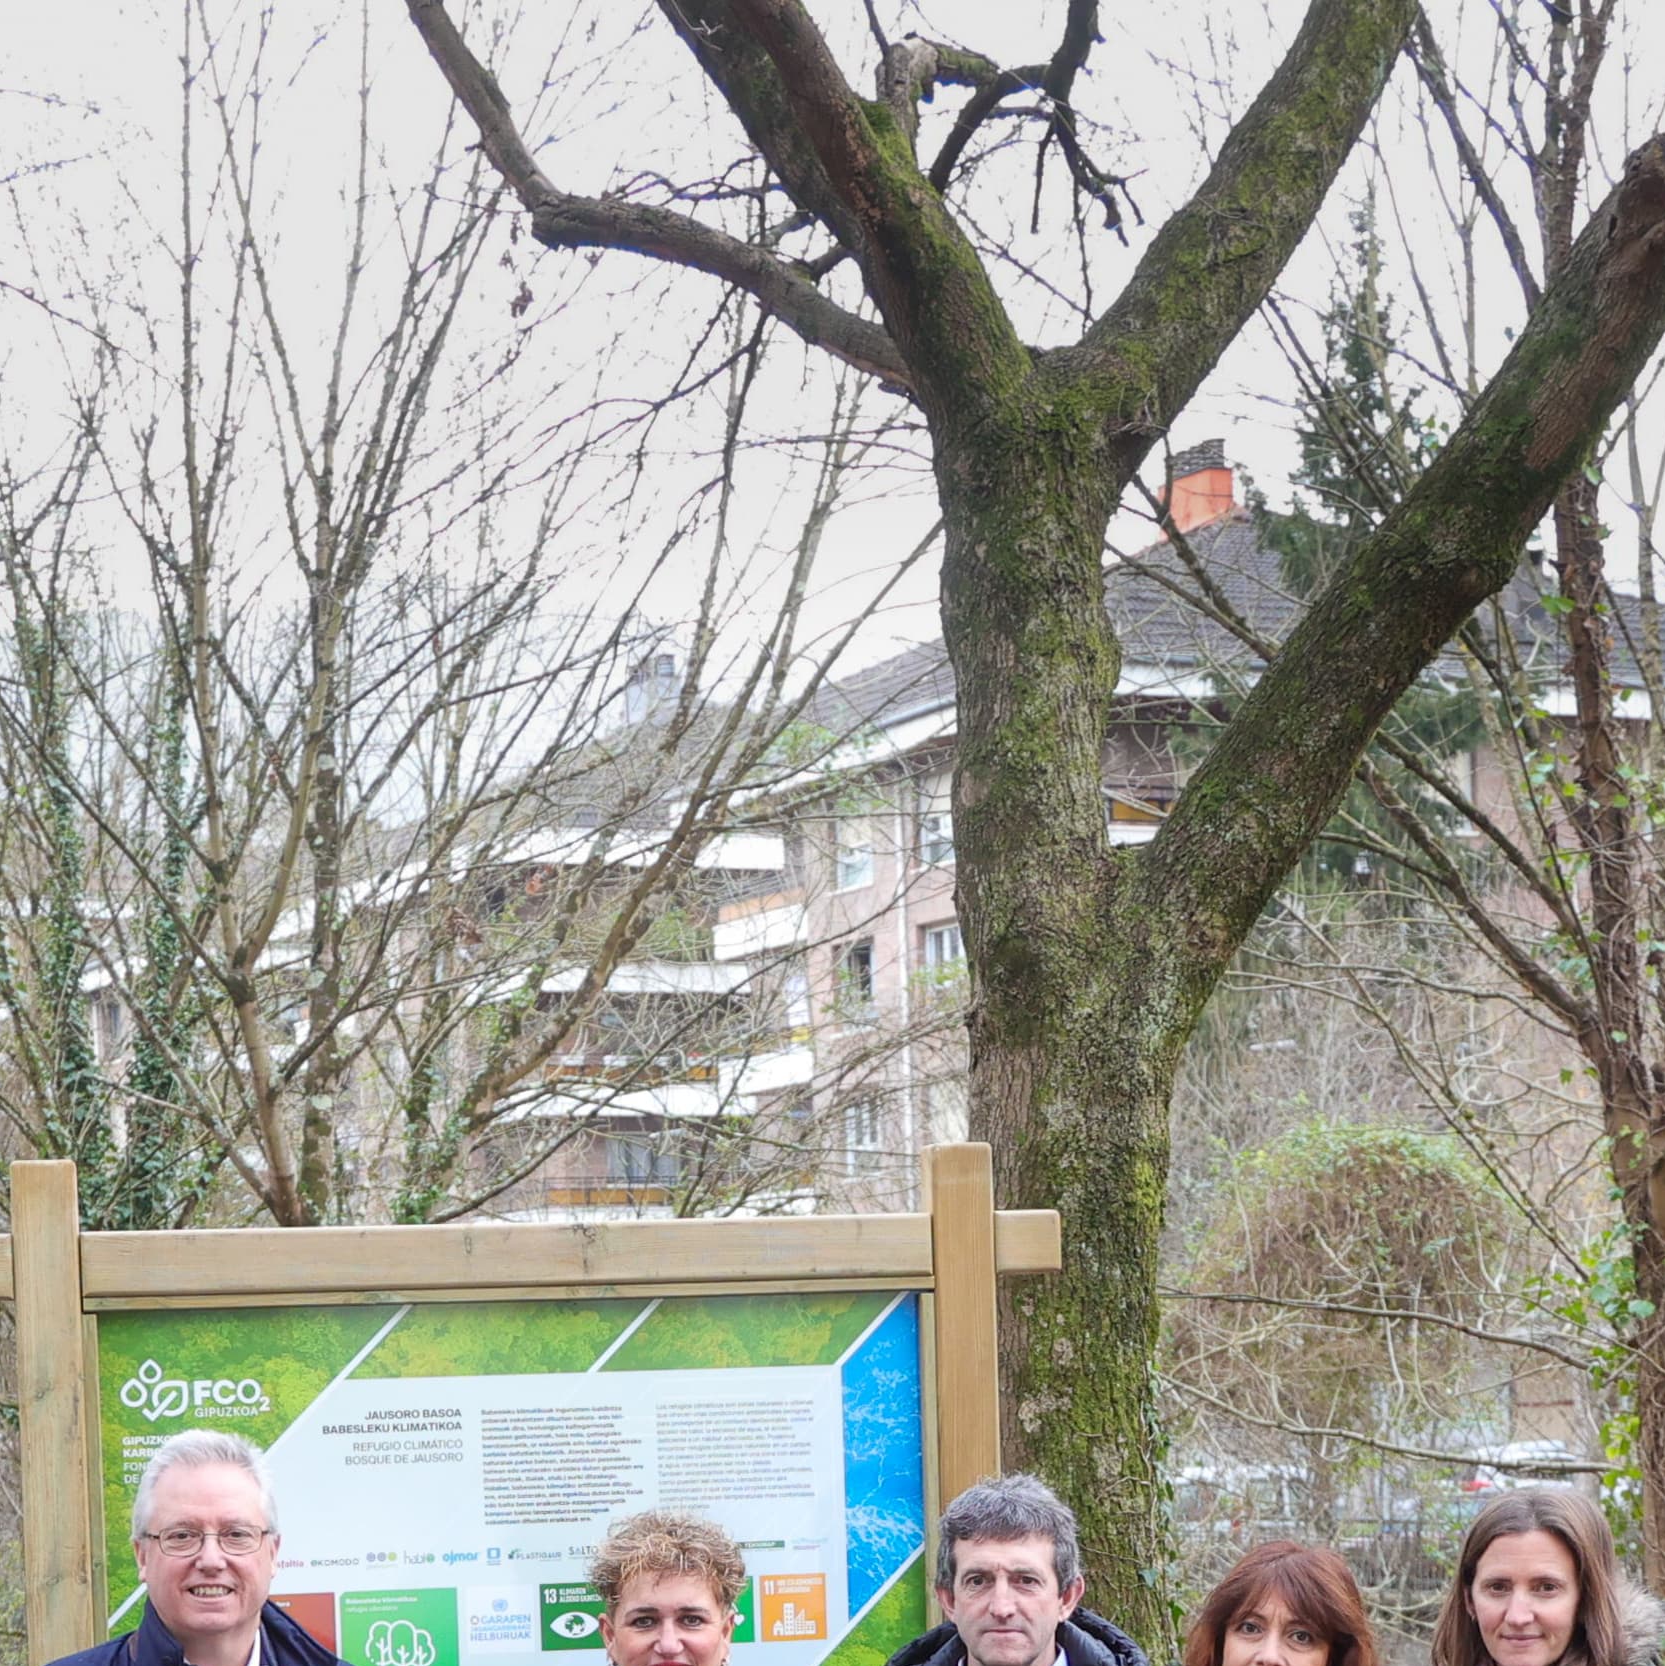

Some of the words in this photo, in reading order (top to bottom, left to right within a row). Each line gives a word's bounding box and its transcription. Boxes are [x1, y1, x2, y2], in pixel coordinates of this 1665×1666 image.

[194, 1406, 259, 1418] GIPUZKOA
[364, 1409, 420, 1421] JAUSORO
[422, 1408, 462, 1419] BASOA
[322, 1423, 390, 1435] BABESLEKU
[392, 1421, 463, 1433] KLIMATIKOA
[353, 1441, 401, 1452] REFUGIO
[345, 1454, 391, 1466] BOSQUE
[394, 1454, 409, 1464] DE
[411, 1452, 464, 1464] JAUSORO
[442, 1549, 480, 1566] ojmar
[764, 1579, 775, 1596] 11
[544, 1588, 557, 1604] 13
[470, 1631, 532, 1642] HELBURUAK
